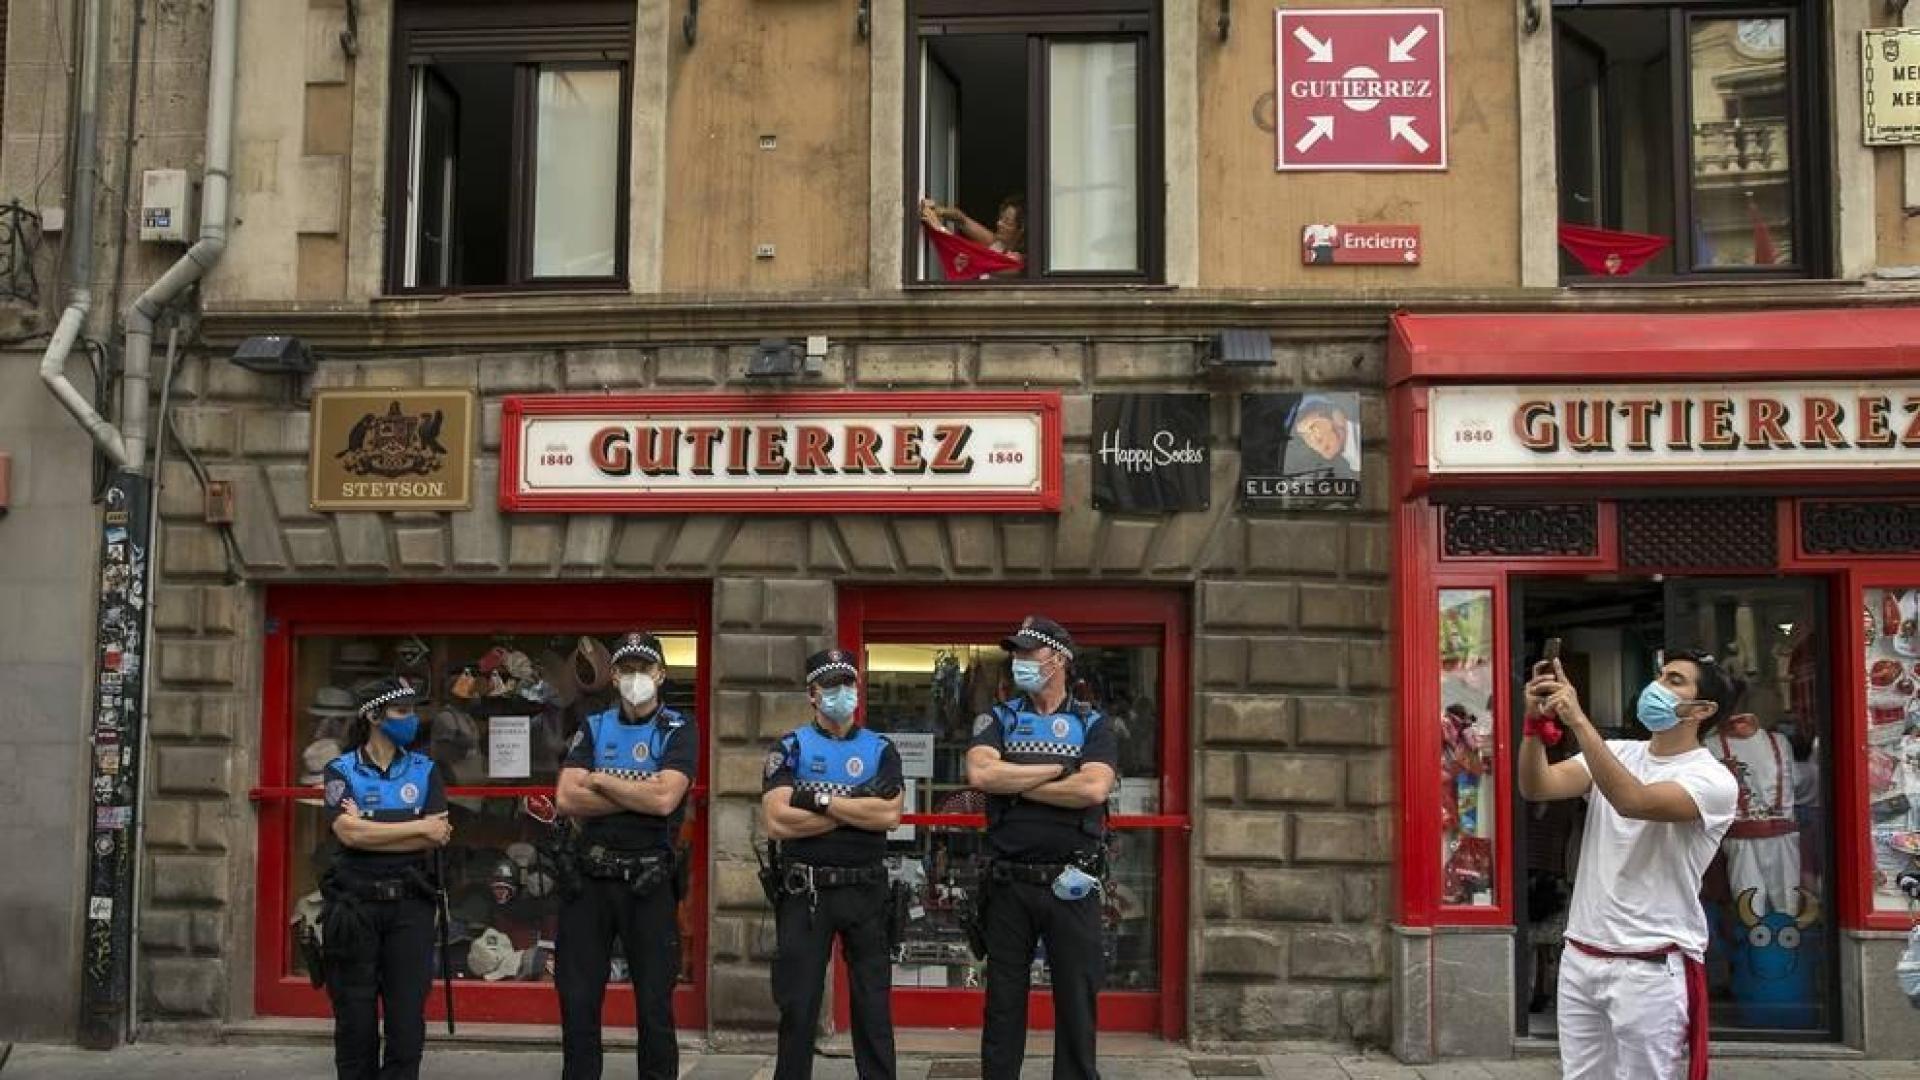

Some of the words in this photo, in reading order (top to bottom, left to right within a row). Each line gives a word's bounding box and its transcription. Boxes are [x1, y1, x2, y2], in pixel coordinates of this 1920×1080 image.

[1893, 66, 1920, 80] ME
[1291, 80, 1432, 97] GUTIERREZ
[1344, 232, 1416, 249] Encierro
[1456, 430, 1493, 442] 1840
[541, 455, 573, 466] 1840
[589, 424, 974, 476] GUTIERREZ
[988, 451, 1023, 464] 1840
[1098, 428, 1153, 473] Happy
[1153, 430, 1204, 466] Socks
[342, 482, 444, 498] STETSON
[1246, 481, 1357, 496] ELOSEGUI
